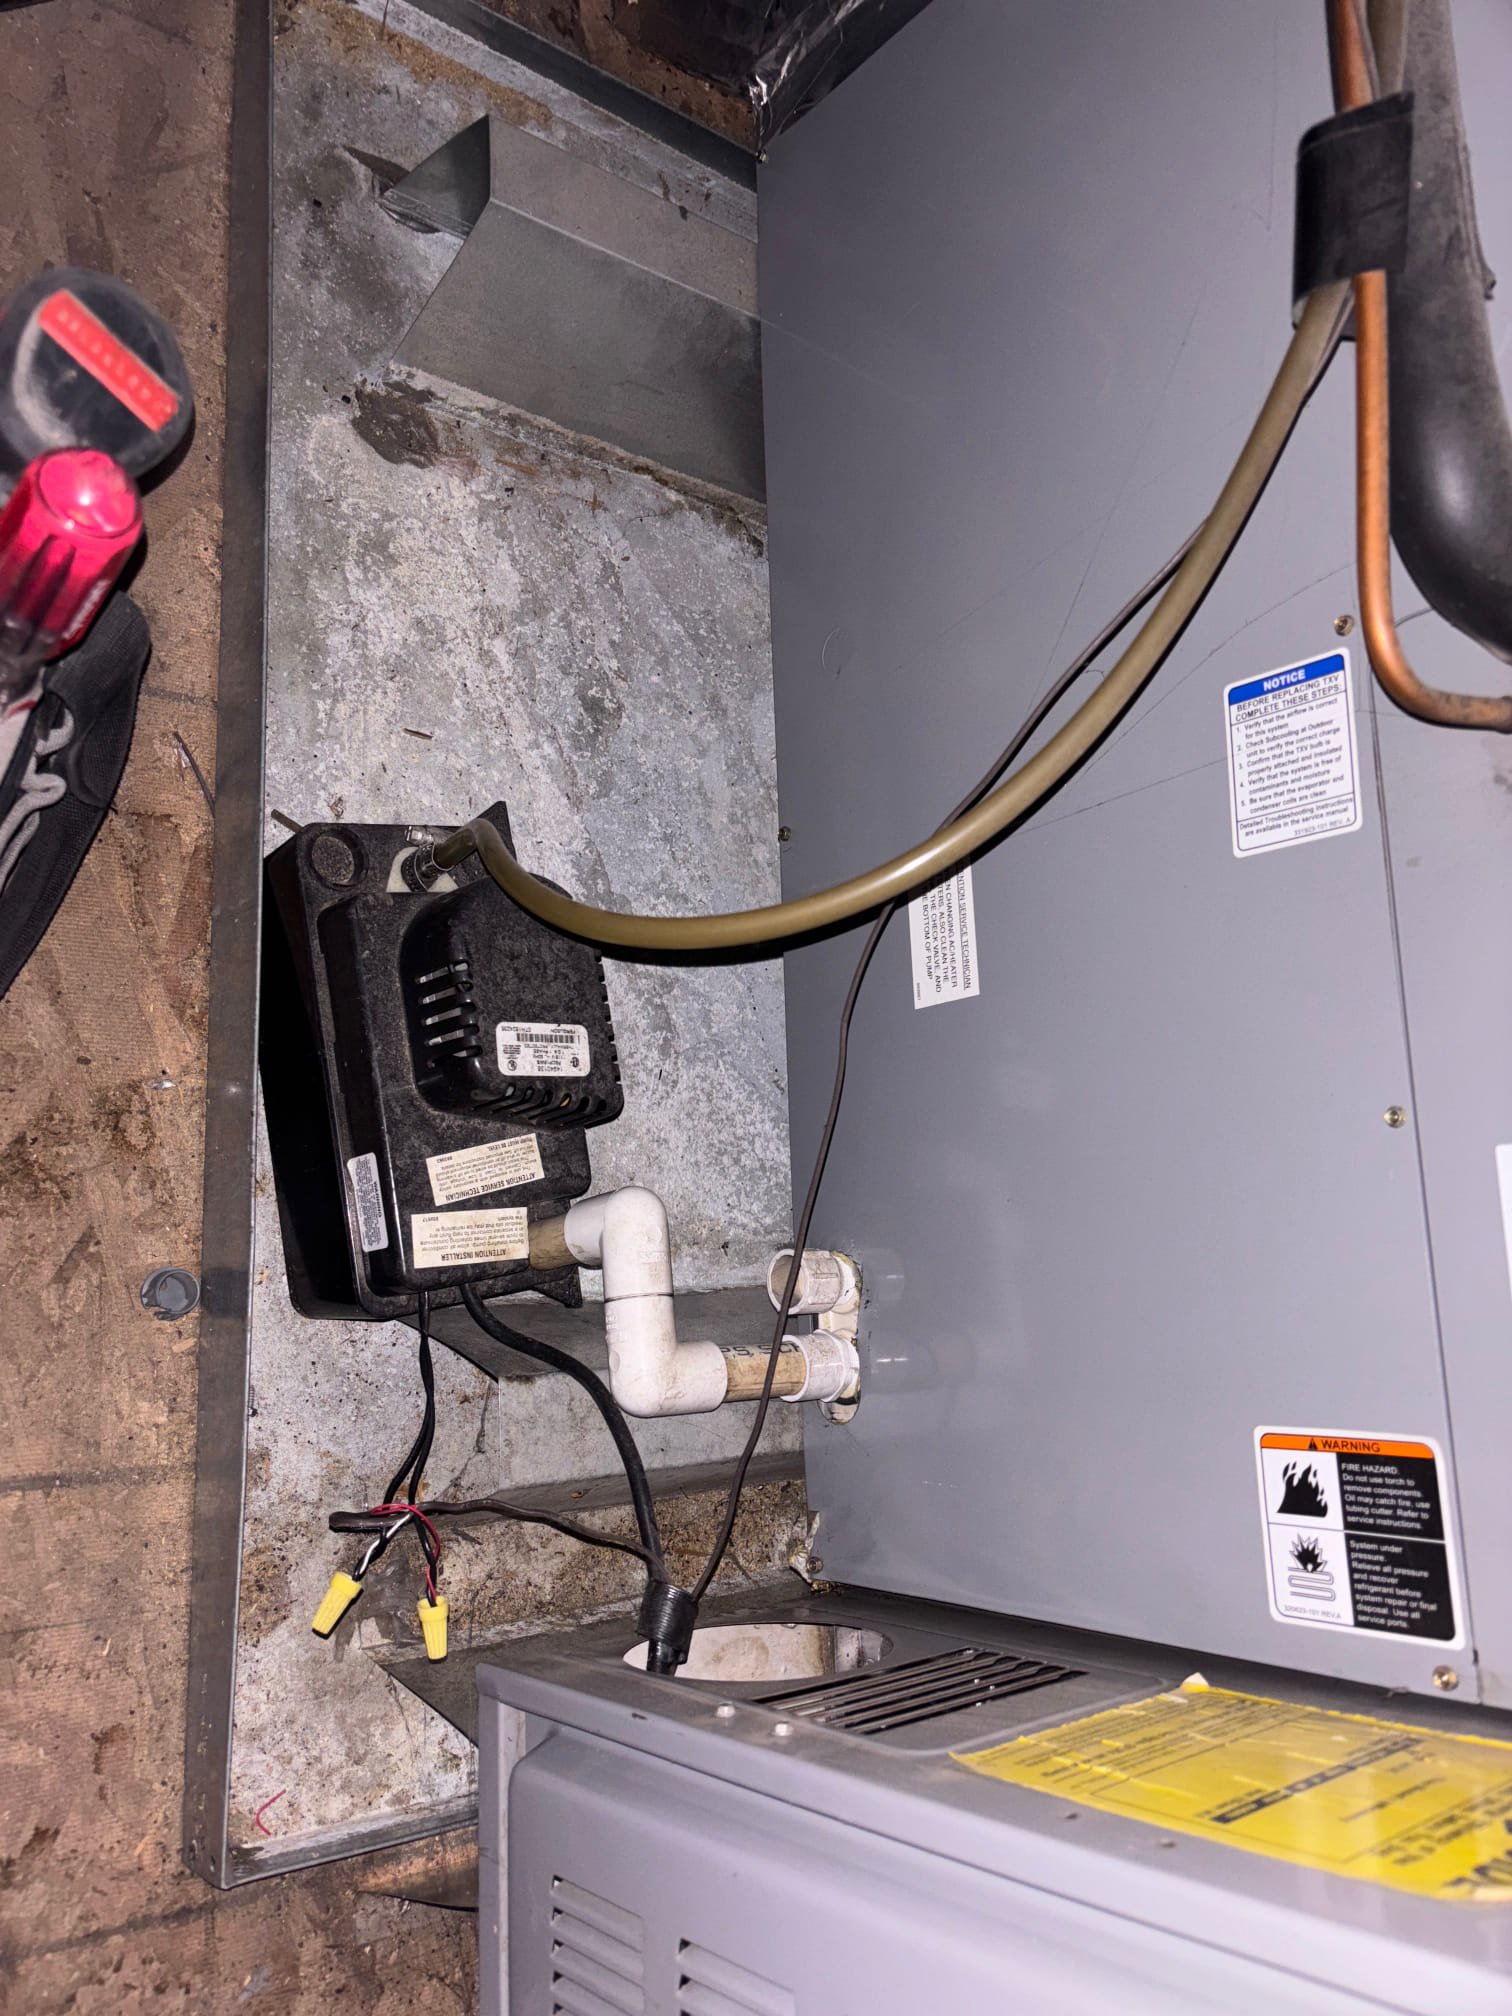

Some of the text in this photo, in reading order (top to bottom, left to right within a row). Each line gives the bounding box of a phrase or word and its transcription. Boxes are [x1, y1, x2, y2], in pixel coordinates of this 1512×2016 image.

[1263, 669, 1305, 691] NOTICE
[1235, 683, 1340, 722] COMPLETE THESE STEPS:
[1237, 674, 1339, 712] BEFORE REPLACING TXV
[1244, 720, 1260, 730] Verify
[1262, 716, 1273, 724] that
[1276, 713, 1284, 721] the
[1286, 707, 1306, 717] airflow
[1315, 698, 1337, 709] correct
[1245, 721, 1288, 739] for this system
[1245, 738, 1263, 748] Check
[1265, 728, 1298, 743] Subcooling
[1308, 718, 1333, 731] Outdoor
[1246, 749, 1257, 757] unit
[1267, 742, 1282, 752] verify
[1284, 739, 1293, 747] the
[1295, 732, 1317, 744] correct
[1318, 726, 1340, 738] charge
[1246, 755, 1269, 766] Confirm
[1271, 751, 1282, 759] that
[1284, 748, 1293, 756] the
[1296, 745, 1307, 753] TXV
[1309, 741, 1322, 749] bulb
[1247, 745, 1342, 777] properly attached and insulated
[1248, 775, 1264, 785] Verify
[1266, 772, 1277, 780] that
[1279, 769, 1288, 777] the
[1290, 763, 1312, 774] system
[1321, 757, 1332, 766] free
[1248, 768, 1330, 794] contaminants and moisture
[1259, 793, 1271, 801] sure
[1273, 789, 1284, 797] that
[1286, 786, 1295, 794] the
[1297, 778, 1330, 792] evaporator
[1332, 774, 1343, 782] and
[1239, 818, 1262, 829] Detailed
[1265, 806, 1313, 824] Troubleshooting
[1315, 796, 1352, 811] Instructions
[1249, 789, 1326, 813] condenser coils are clean
[1244, 828, 1253, 836] are
[1255, 822, 1281, 833] available
[1290, 817, 1299, 825] the
[1302, 812, 1323, 822] service
[921, 904, 930, 939] BOTTOM
[944, 892, 954, 937] CHANGING
[930, 913, 938, 942] CHECK
[957, 875, 971, 989] NTION SERVICE TECHNICIAN
[924, 941, 931, 953] OF
[940, 935, 948, 964] CLEAN
[925, 955, 933, 980] PUMP
[948, 939, 958, 987] AC/HEATER
[445, 1171, 535, 1201] ATTENTION SERVICE TECHNICIAN
[441, 1248, 506, 1260] ATTENTION INSTALLER
[1321, 1439, 1380, 1452] WARNING
[1341, 1463, 1398, 1474] FIRE HAZARD.
[1343, 1484, 1423, 1497] remove components.
[1385, 1477, 1404, 1485] torch
[1344, 1494, 1354, 1502] Oil
[1375, 1497, 1395, 1505] catch
[1415, 1500, 1429, 1508] use
[1346, 1505, 1368, 1514] tubing
[1370, 1507, 1393, 1515] cutter.
[1396, 1509, 1419, 1517] Refer
[1347, 1515, 1422, 1528] service instructions.
[1349, 1541, 1402, 1552] System under
[1351, 1551, 1386, 1562] pressure.
[1352, 1561, 1379, 1571] Relieve
[1393, 1566, 1428, 1578] pressure
[1353, 1572, 1398, 1583] and recover
[1354, 1582, 1421, 1598] refrigerant before
[1355, 1593, 1382, 1604] system
[1385, 1597, 1406, 1607] repair
[1419, 1601, 1436, 1610] final
[1356, 1603, 1388, 1615] disposal.
[1393, 1608, 1408, 1617] Use
[1358, 1614, 1408, 1628] service ports.
